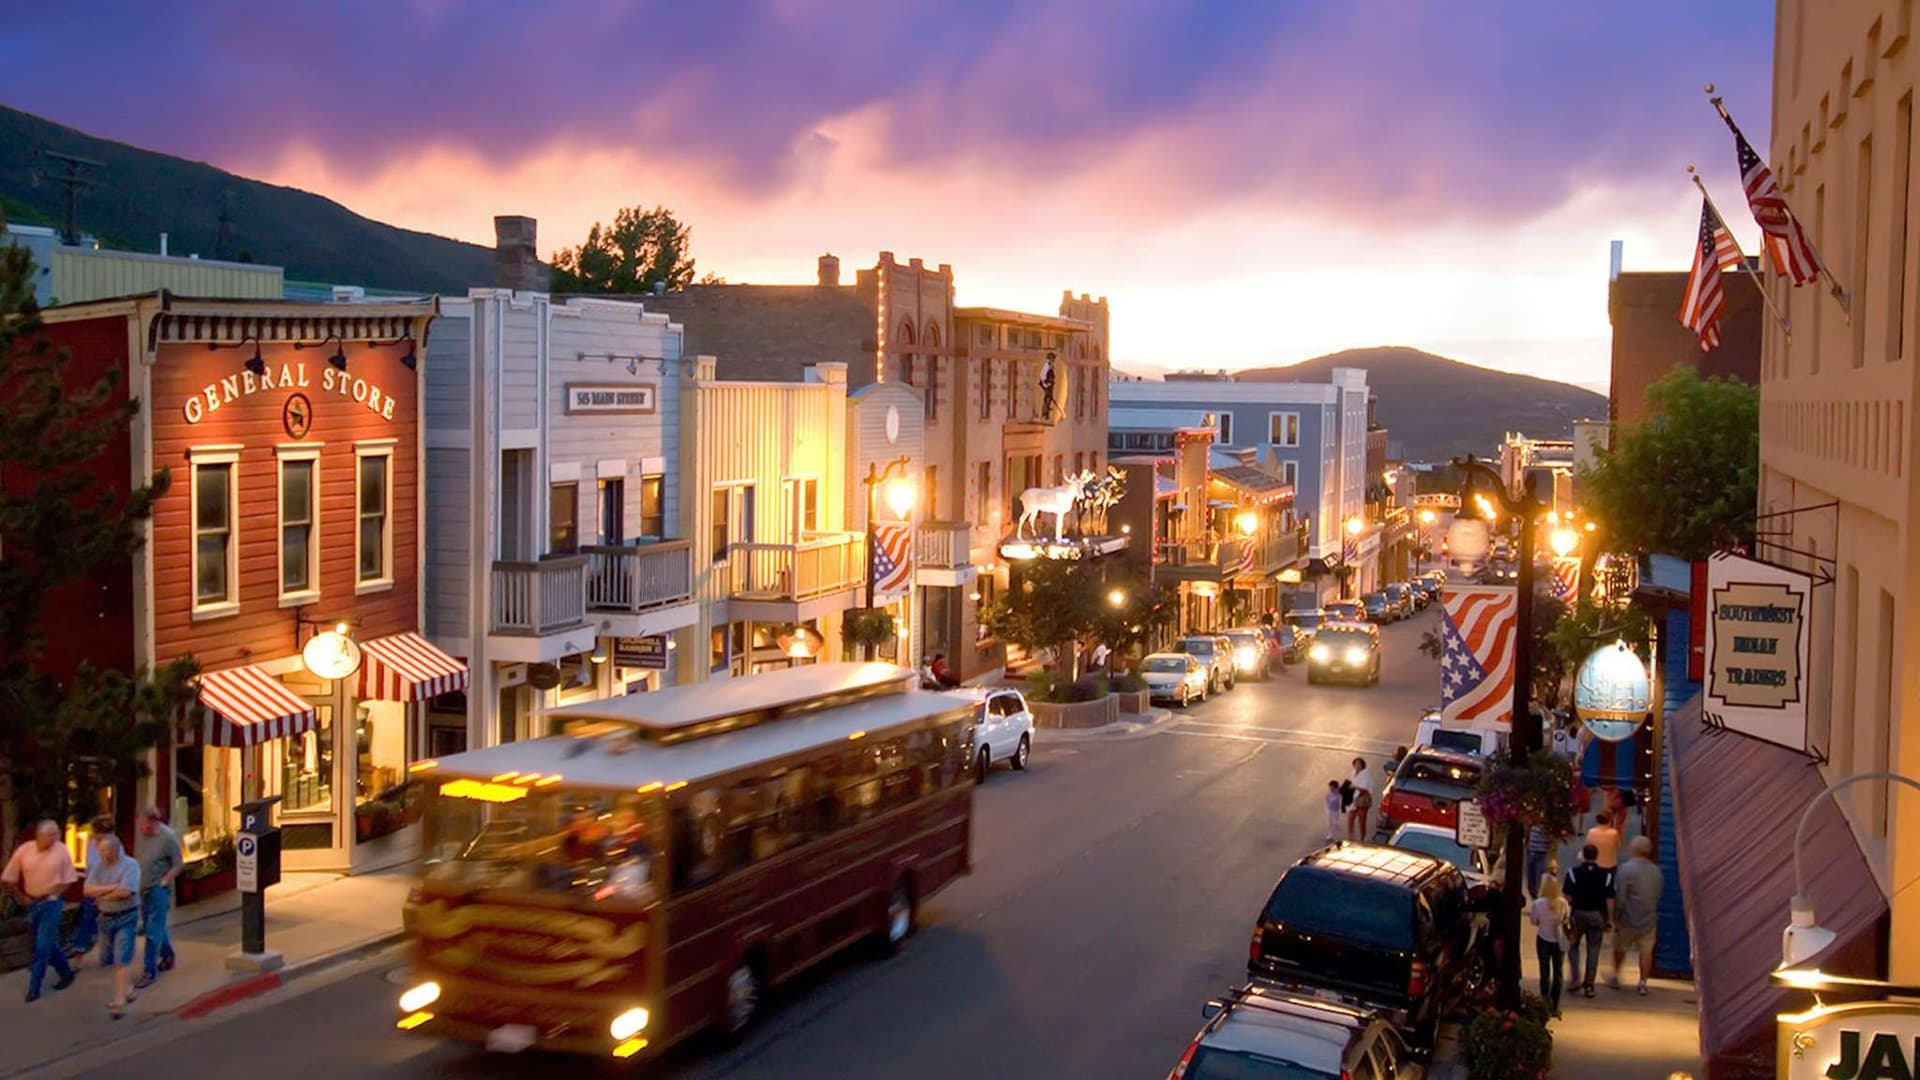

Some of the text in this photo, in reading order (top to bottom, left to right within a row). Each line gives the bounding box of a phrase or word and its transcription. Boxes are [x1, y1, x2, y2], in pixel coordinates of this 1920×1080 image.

[184, 363, 396, 424] GENERAL STORE
[591, 391, 615, 405] MAIN
[616, 391, 646, 405] STREET
[1719, 603, 1796, 624] SOUTHWEST
[1733, 636, 1779, 655] INDIAN
[1726, 667, 1787, 688] TRADERS
[246, 815, 256, 830] P
[242, 840, 253, 855] P
[1824, 1029, 1920, 1080] JA
